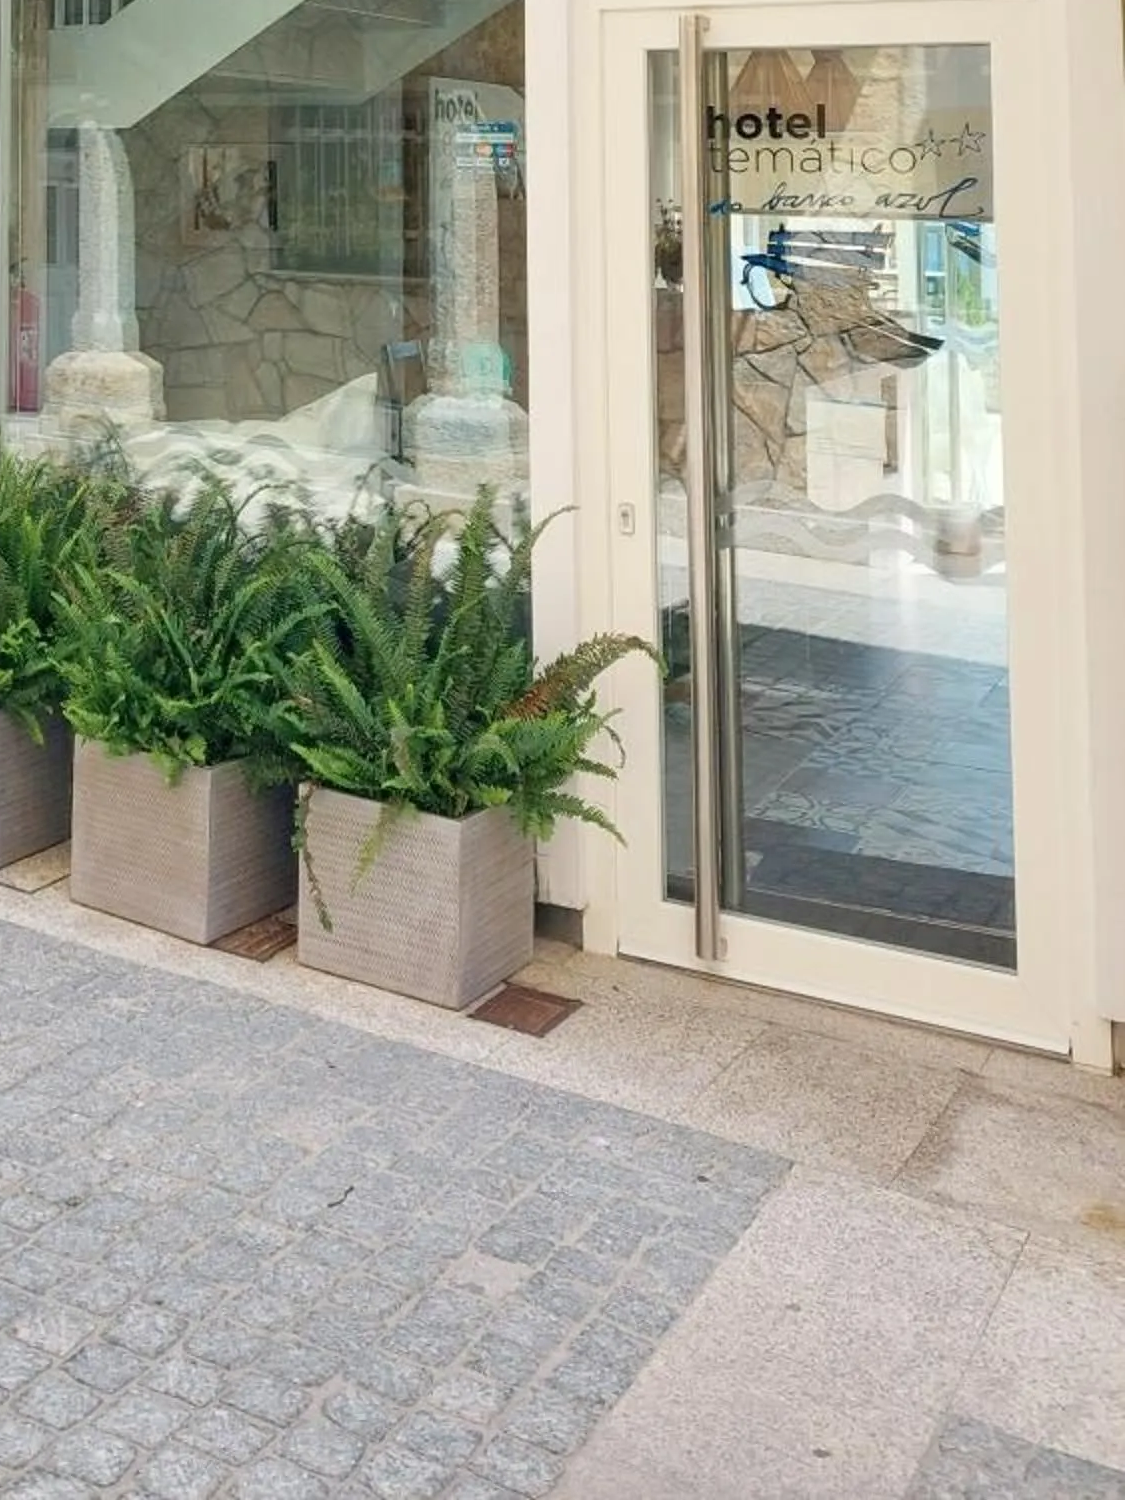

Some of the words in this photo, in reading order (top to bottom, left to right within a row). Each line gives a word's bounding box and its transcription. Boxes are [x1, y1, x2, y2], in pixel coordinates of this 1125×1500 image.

[706, 103, 826, 140] hotel
[708, 139, 917, 175] temático
[874, 177, 985, 218] azul
